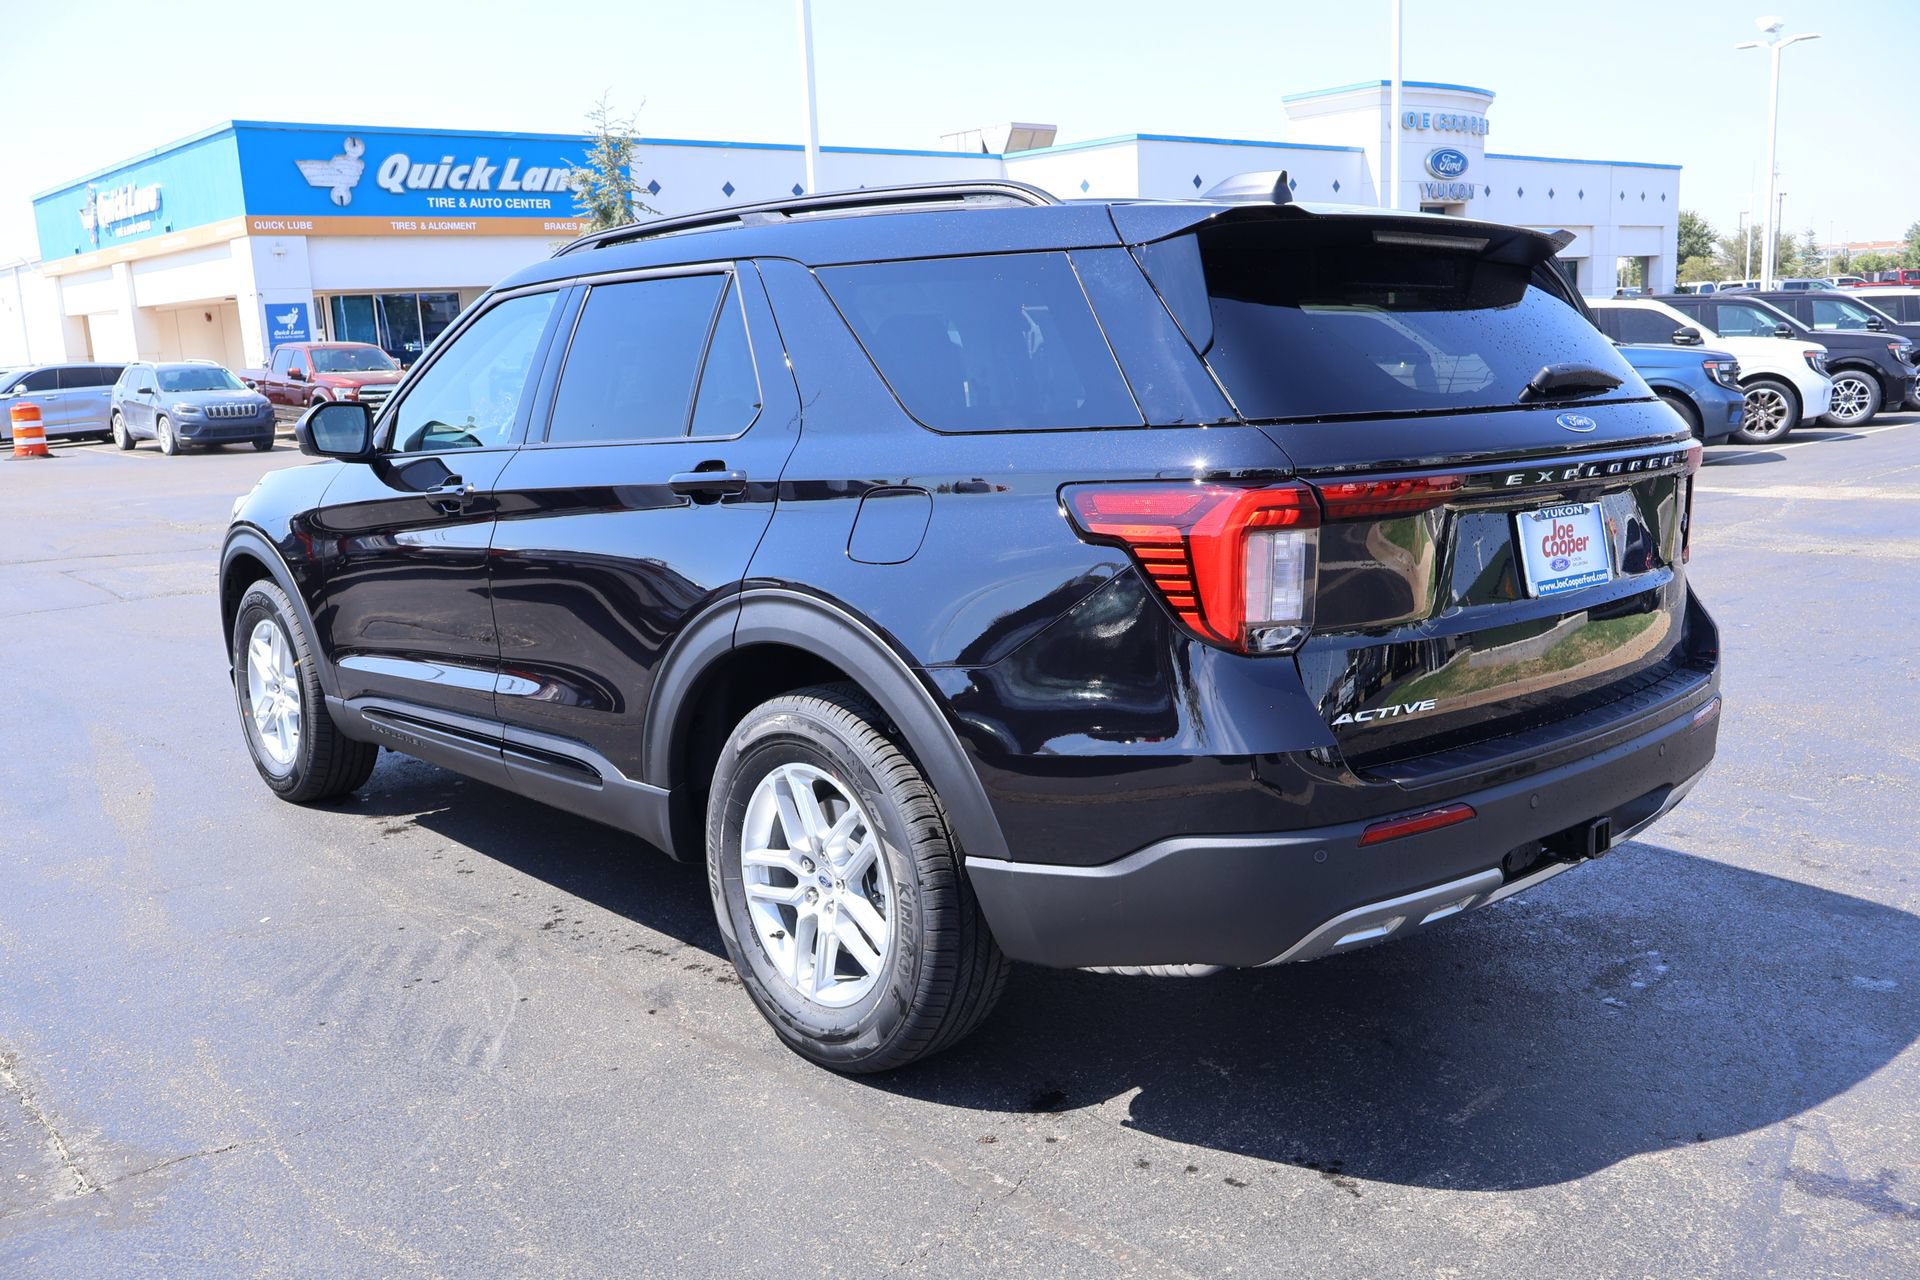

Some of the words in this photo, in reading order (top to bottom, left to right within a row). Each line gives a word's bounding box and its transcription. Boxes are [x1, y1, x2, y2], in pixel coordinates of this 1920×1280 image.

[377, 153, 496, 194] Quick
[1419, 183, 1475, 200] YUKON
[427, 197, 456, 209] TIRE
[459, 198, 468, 209] &
[470, 198, 502, 209] AUTO
[505, 198, 551, 210] CENTER
[254, 220, 286, 230] QUICK
[287, 221, 313, 230] LUBE
[391, 221, 417, 230] TIRES
[421, 222, 428, 230] &
[429, 221, 477, 231] ALIGNMENT
[544, 222, 578, 231] BRAKES
[1505, 455, 1677, 486] EXPLORER
[1542, 505, 1583, 519] YUKON
[1550, 518, 1574, 541] Joe
[1541, 535, 1590, 558] Cooper
[1538, 572, 1608, 593] www.JoeCooperFord.com
[1330, 698, 1439, 725] ACTIVE
